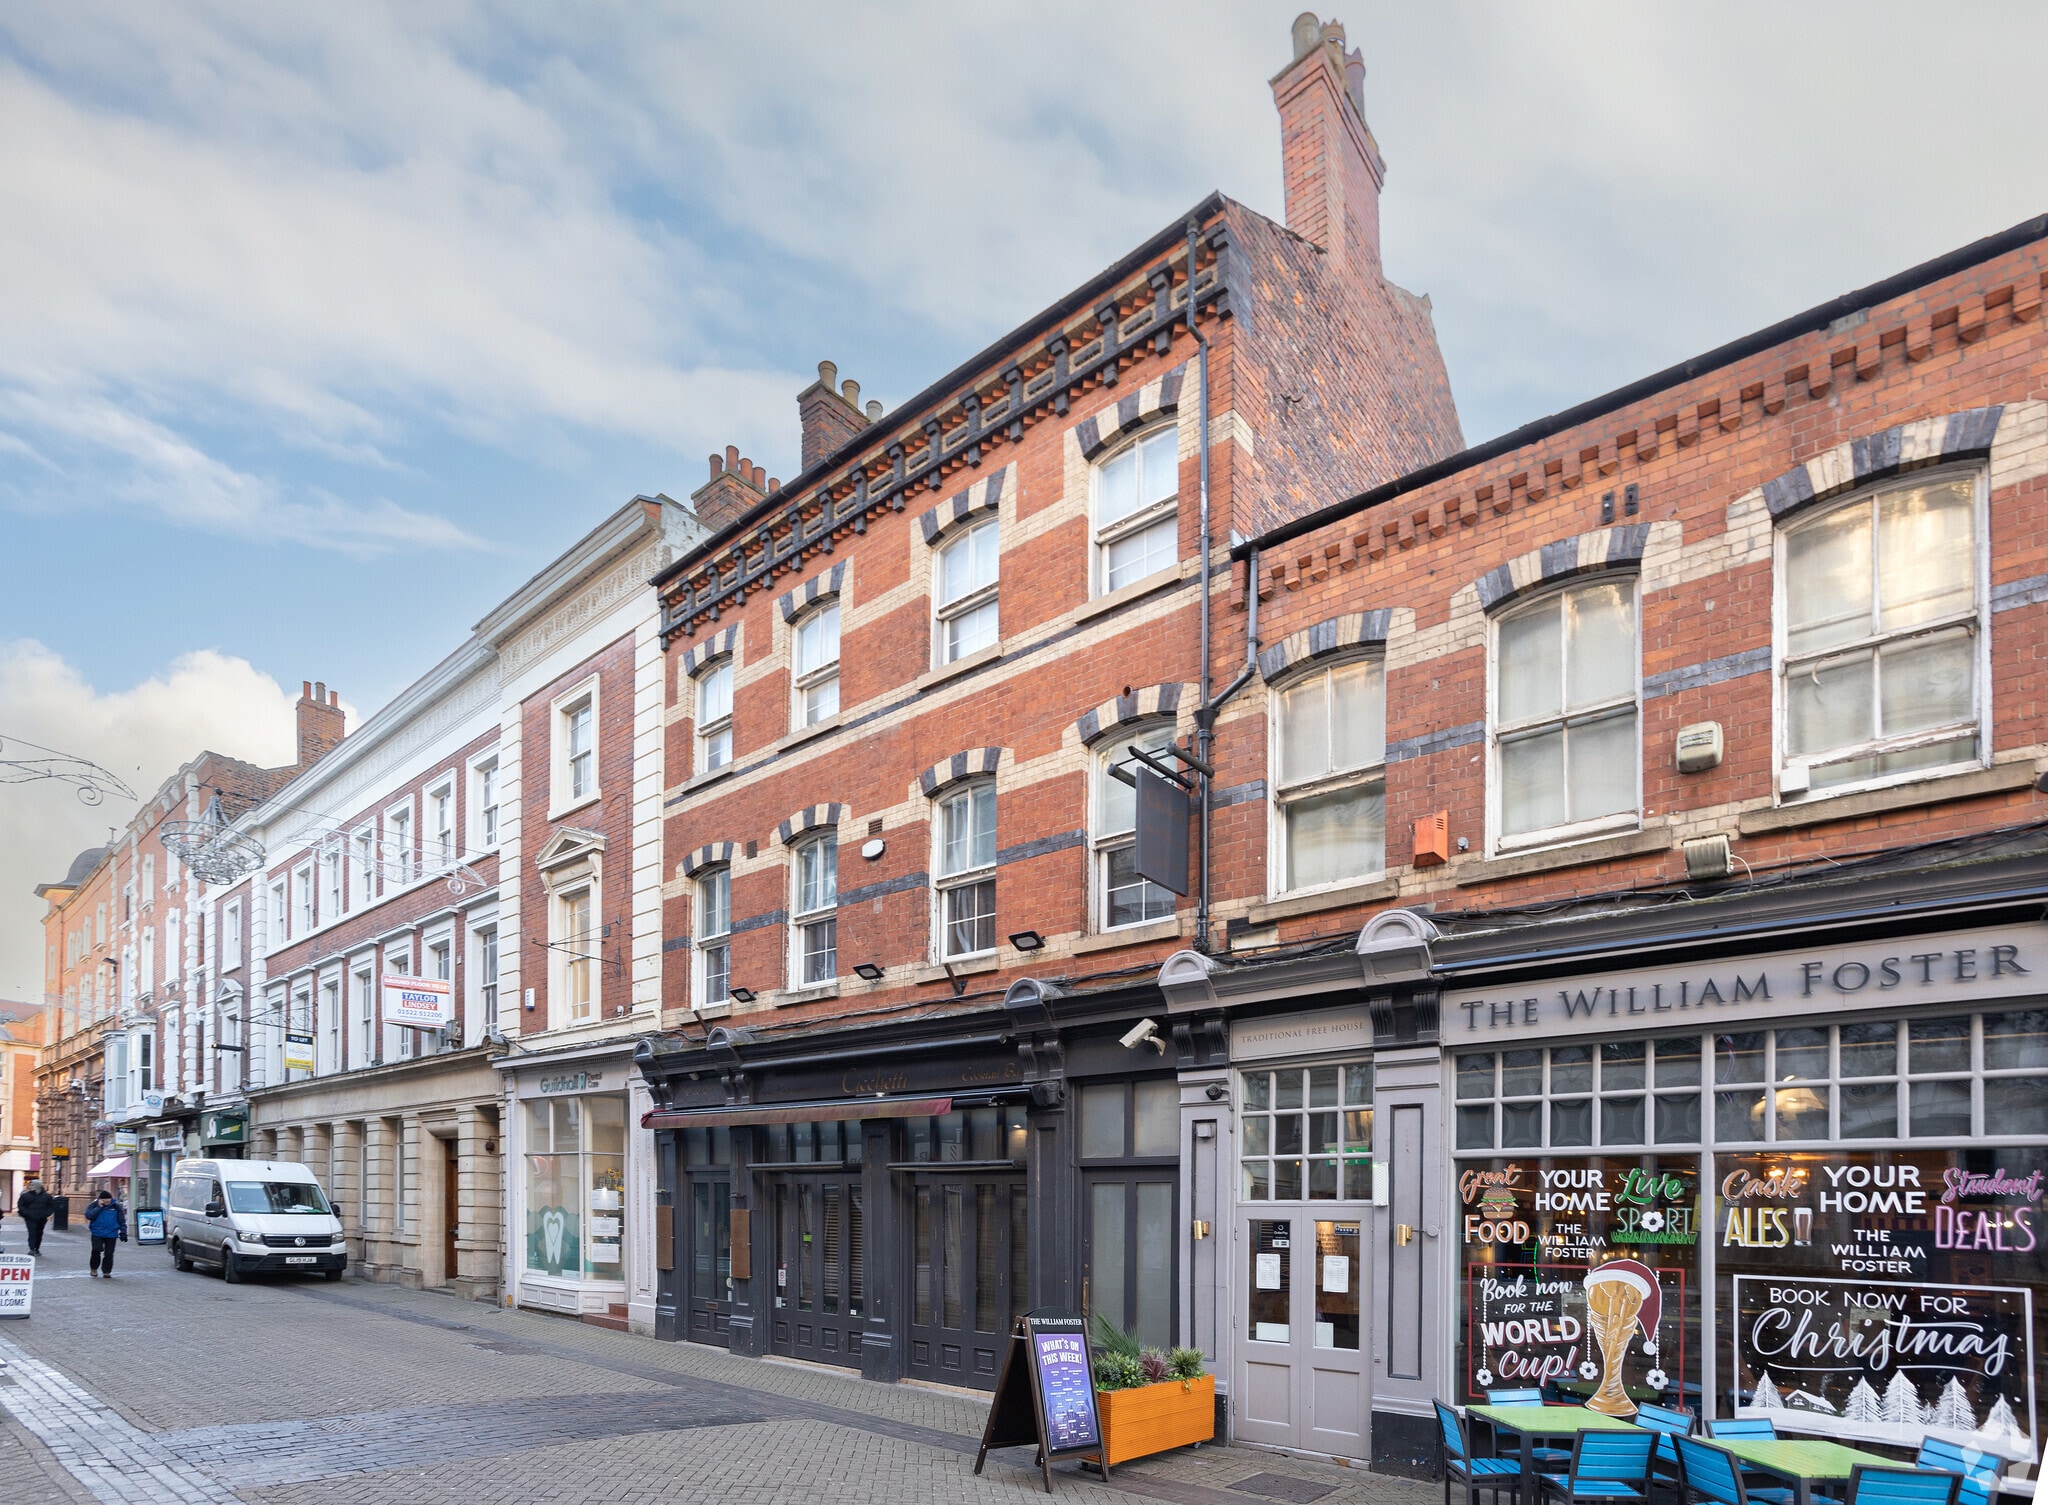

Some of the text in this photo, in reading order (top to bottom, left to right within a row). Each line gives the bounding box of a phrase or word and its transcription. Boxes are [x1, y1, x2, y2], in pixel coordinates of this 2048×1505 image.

[1460, 944, 2032, 1029] THE WILLIAM FOSTER
[404, 993, 436, 1002] TAYLOR
[404, 1001, 436, 1010] LINDSEY
[397, 1008, 418, 1016] 01522
[419, 1010, 443, 1018] 512200
[1241, 1021, 1365, 1044] TRADITIONAL FREE HOUSE
[540, 1074, 579, 1093] Guildhall
[1459, 1163, 1523, 1205] Great
[1539, 1169, 1604, 1189] YOUR
[1722, 1166, 1802, 1200] Cask
[1823, 1165, 1921, 1187] YOUR
[1941, 1167, 2045, 1205] Student
[1614, 1167, 1686, 1206] Live
[1535, 1192, 1611, 1212] HOME
[1820, 1191, 1927, 1214] HOME
[1465, 1214, 1531, 1245] FOOD
[1556, 1223, 1582, 1234] THE
[1723, 1207, 1790, 1248] ALES
[1853, 1229, 1891, 1242] THE
[1538, 1235, 1607, 1247] WILLIAM
[1545, 1247, 1595, 1259] FOSTER
[1830, 1244, 1927, 1259] WILLIAM
[0, 1268, 31, 1281] PEN
[1841, 1259, 1913, 1274] FOSTER
[1480, 1274, 1573, 1302] Book now
[0, 1298, 25, 1306] LCOME
[1504, 1300, 1553, 1315] FOR THE
[1769, 1287, 1970, 1315] BOOK NOW FOR
[1041, 1318, 1063, 1326] WILLIAM
[1064, 1318, 1082, 1326] FOSTER
[1481, 1316, 1582, 1348] WORLD
[1041, 1337, 1079, 1353] WHAT'S ON
[1752, 1308, 2014, 1377] Christmas
[1041, 1351, 1082, 1366] THIS WEEK!
[1498, 1346, 1580, 1389] Cup!
